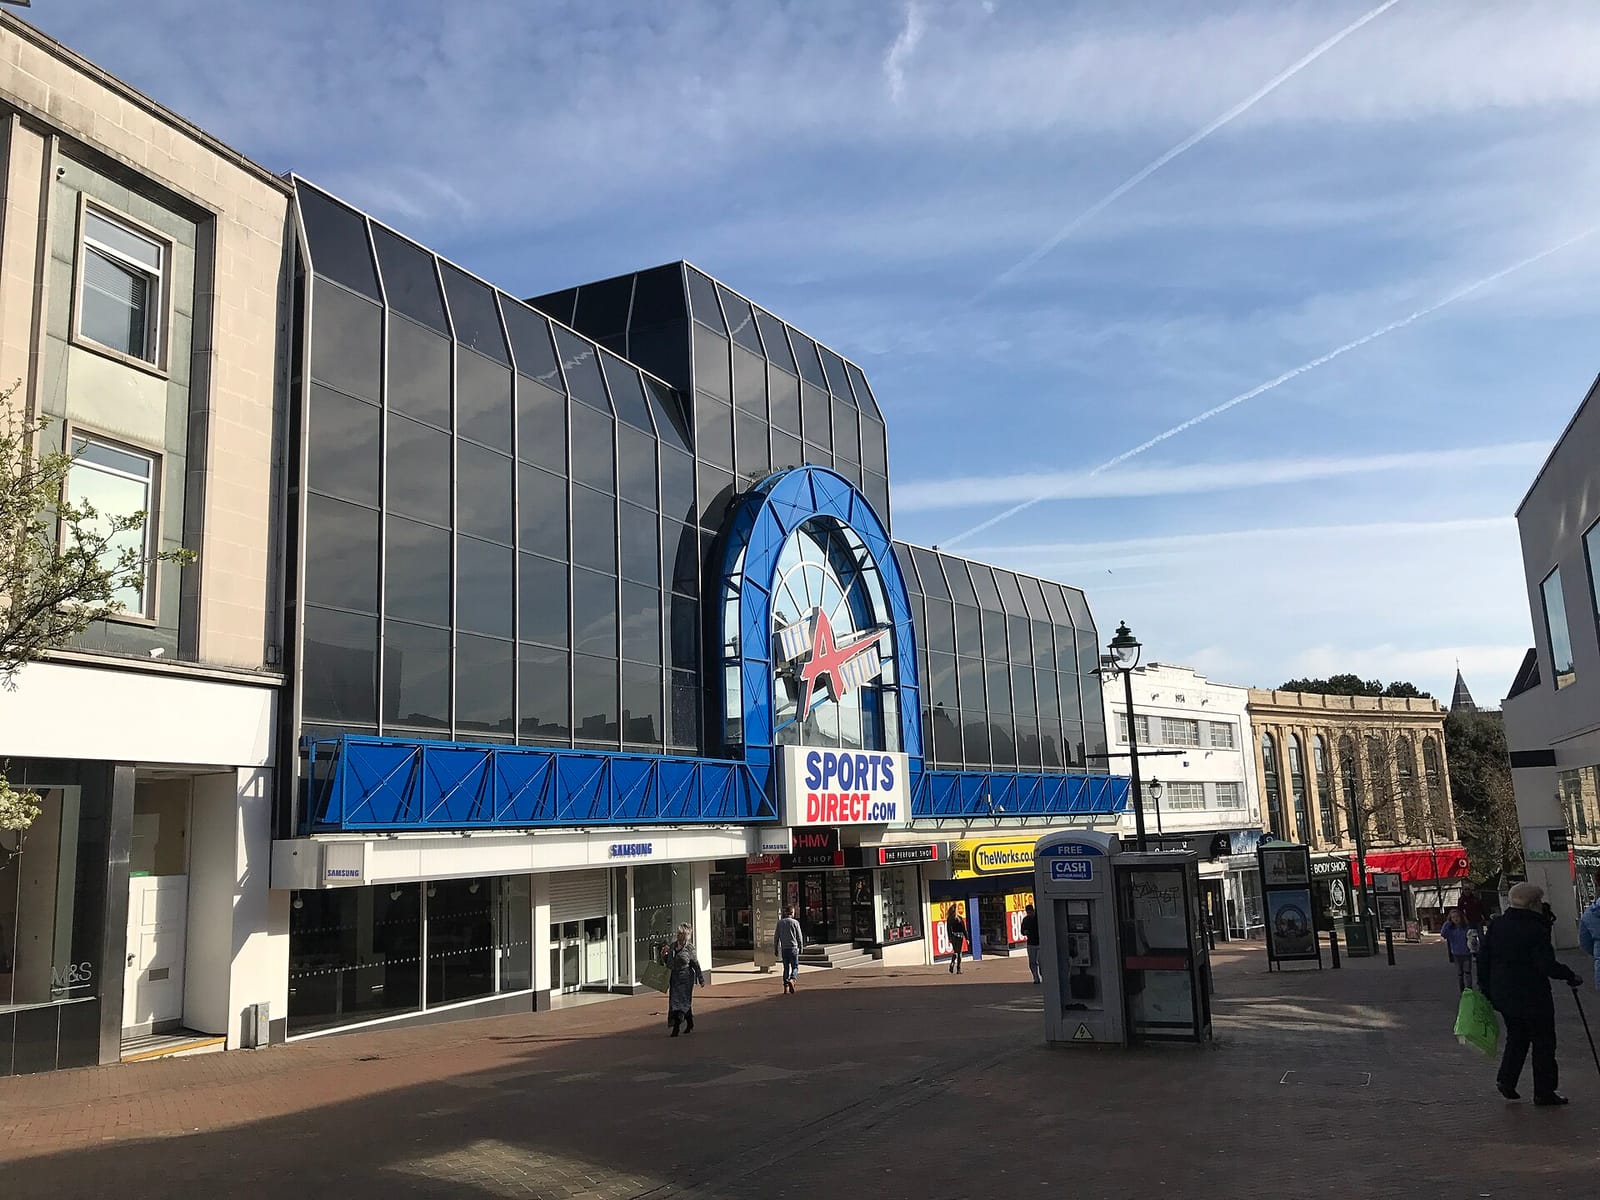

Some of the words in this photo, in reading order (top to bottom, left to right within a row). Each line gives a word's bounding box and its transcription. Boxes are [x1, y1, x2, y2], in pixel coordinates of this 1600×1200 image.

[805, 751, 895, 792] SPORTS
[806, 793, 897, 822] DIRECT.COM
[799, 834, 829, 848] HMV
[612, 843, 653, 856] SAMSUNG
[886, 852, 895, 860] THE
[897, 850, 918, 858] PERFUME
[919, 849, 932, 857] SHOP
[1058, 846, 1083, 854] FREE
[807, 855, 832, 864] SHOP
[327, 869, 360, 877] SAMSUNG
[1055, 862, 1086, 872] CASH
[1313, 863, 1330, 874] BODY
[1013, 892, 1028, 910] SALE
[51, 961, 92, 985] M&S
